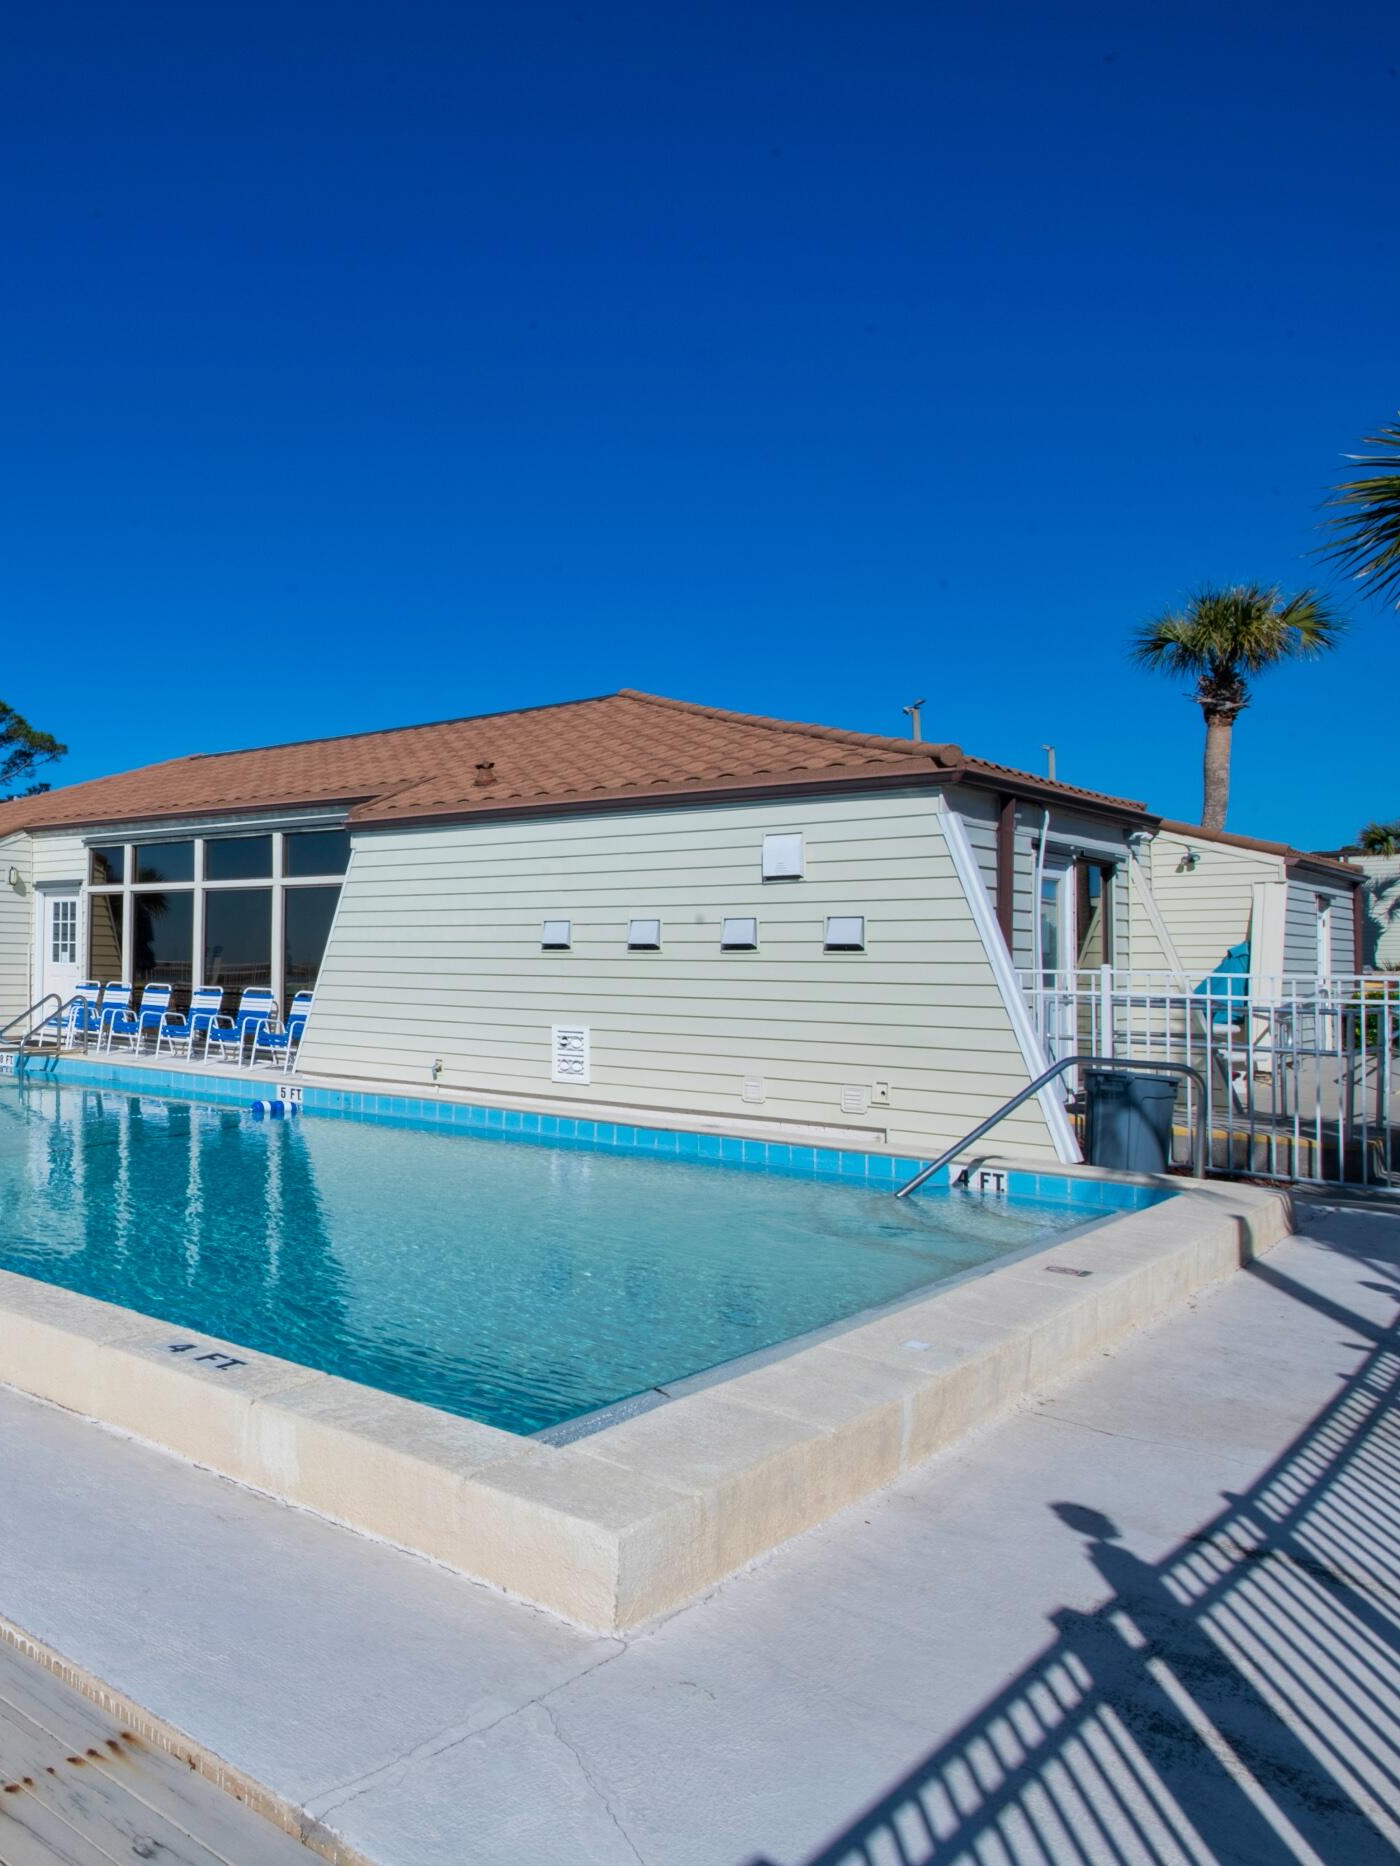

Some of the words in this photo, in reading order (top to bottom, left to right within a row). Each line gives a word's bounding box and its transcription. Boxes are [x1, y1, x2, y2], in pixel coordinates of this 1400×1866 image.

[280, 1087, 286, 1098] 5
[957, 1169, 970, 1187] 4
[980, 1171, 1005, 1192] FT.
[168, 1344, 198, 1353] 4
[193, 1352, 249, 1371] FT.
